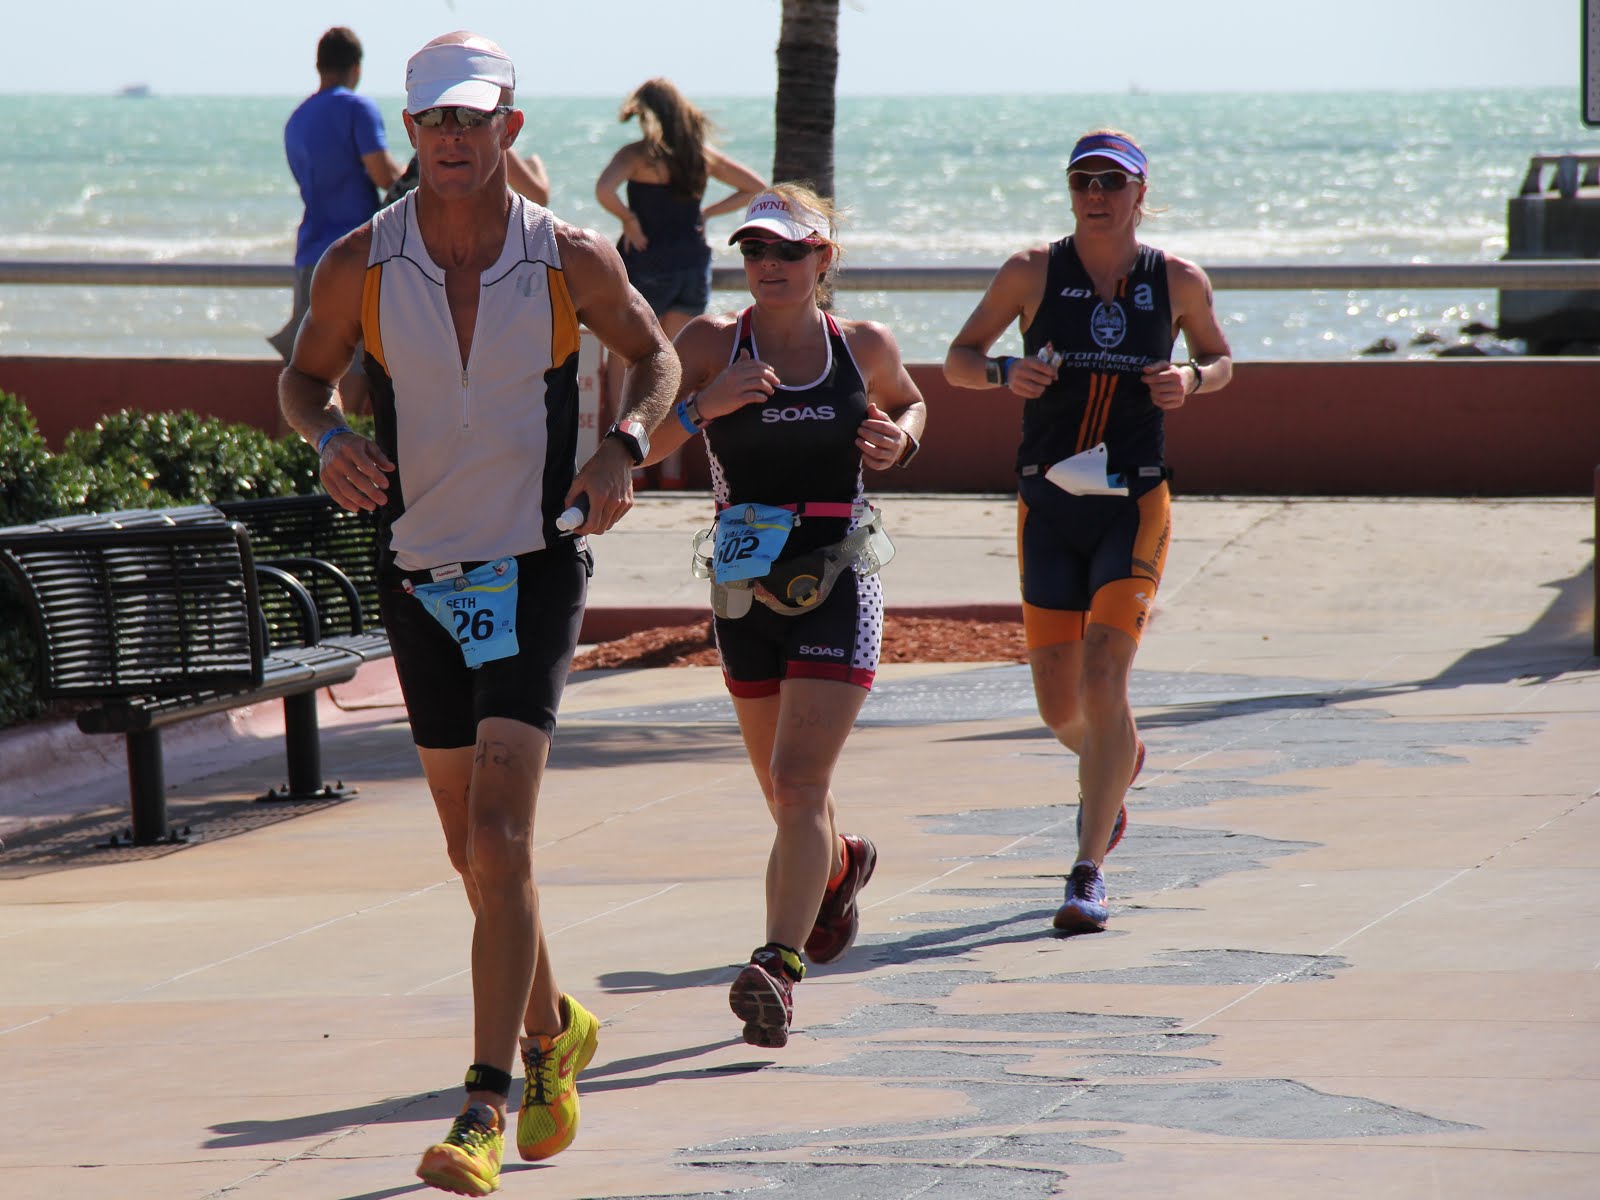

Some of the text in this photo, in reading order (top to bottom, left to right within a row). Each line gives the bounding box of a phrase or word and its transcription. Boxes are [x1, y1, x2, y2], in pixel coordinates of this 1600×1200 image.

[761, 405, 836, 423] SOAS
[446, 597, 476, 609] SETH
[452, 608, 495, 645] 26
[799, 645, 845, 657] SOAS
